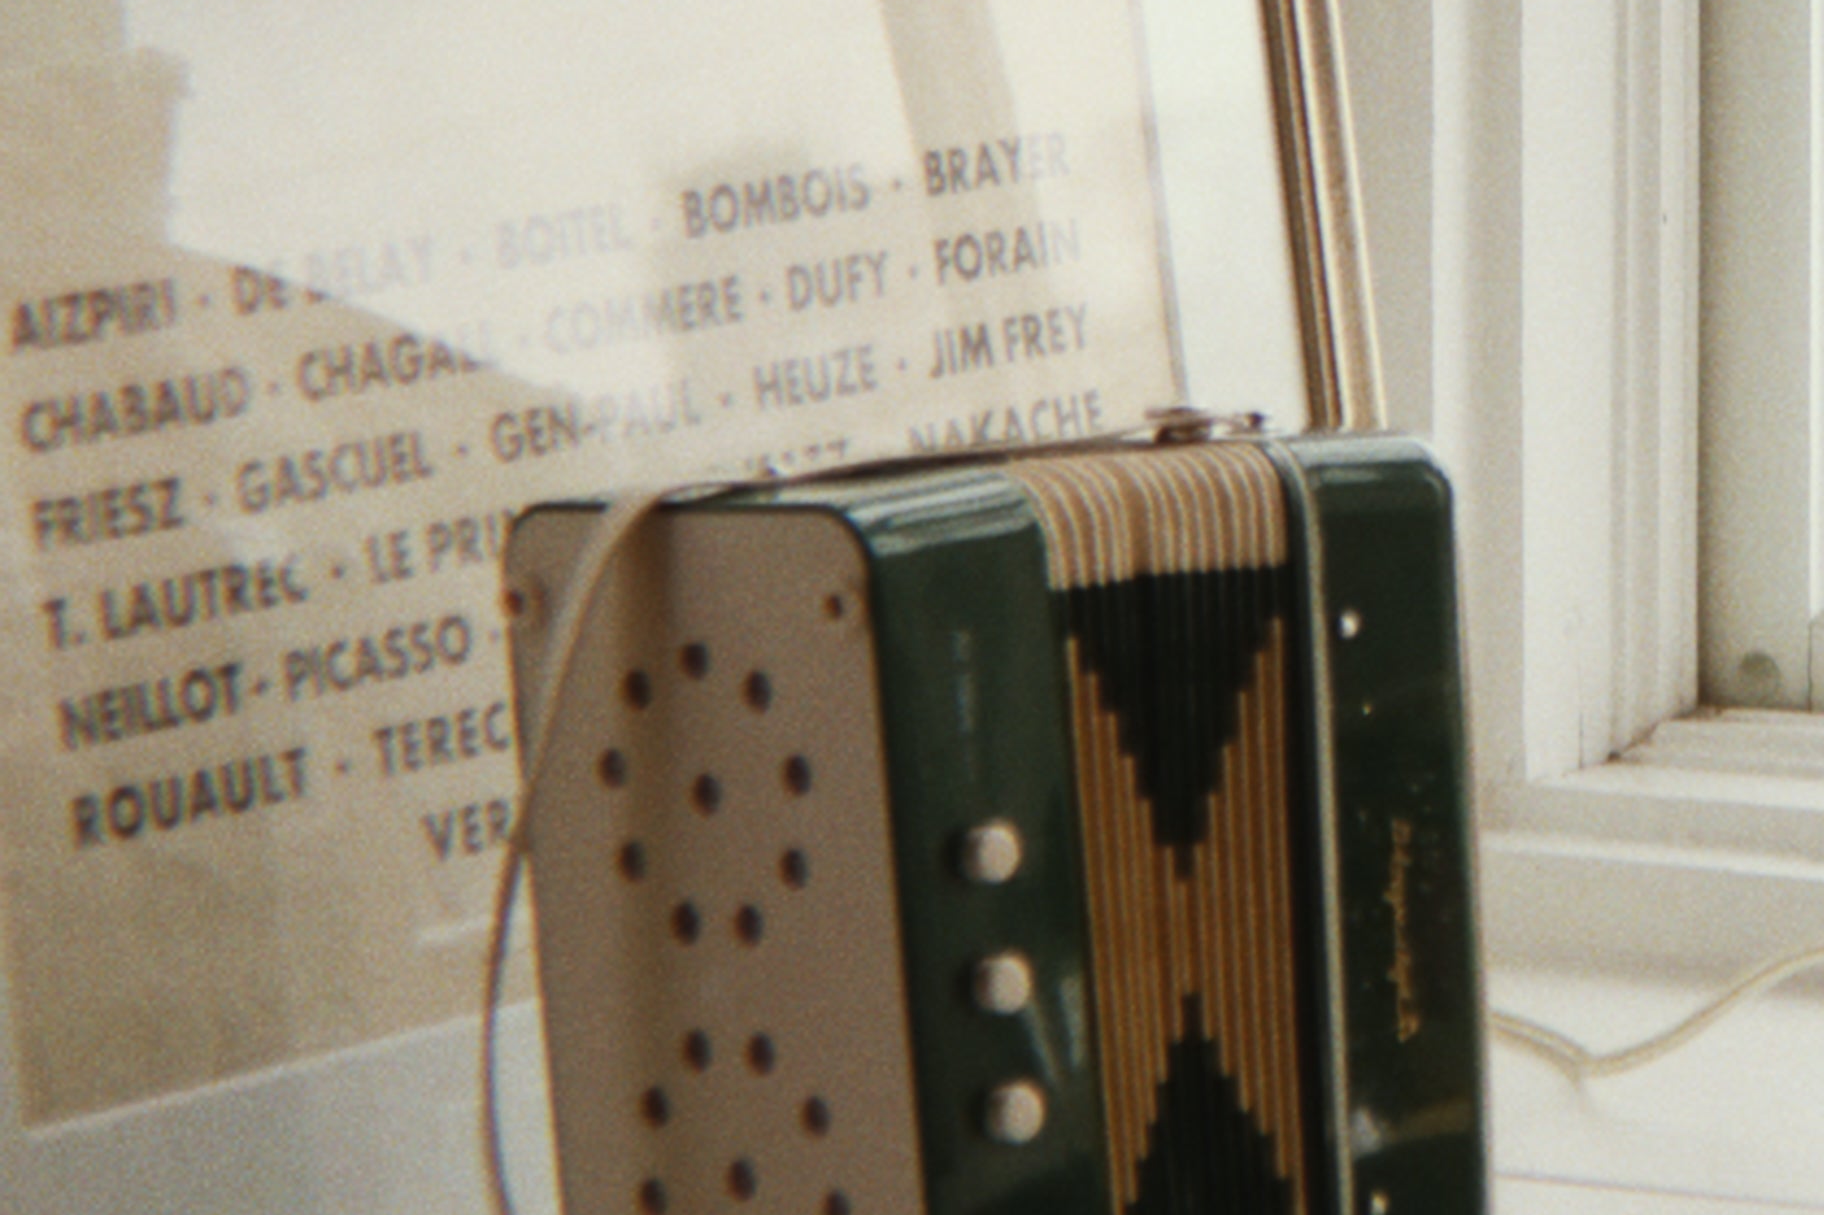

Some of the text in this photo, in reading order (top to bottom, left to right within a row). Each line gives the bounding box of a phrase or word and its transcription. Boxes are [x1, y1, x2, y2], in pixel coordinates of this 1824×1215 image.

[231, 264, 288, 316] DE
[495, 204, 634, 270] BOITEL
[681, 163, 872, 239] BOMBOIS
[923, 132, 1070, 198] BRAYER
[20, 364, 249, 453] CHABAUD
[544, 274, 743, 356] COMMERE
[786, 250, 888, 312] DUFY
[932, 218, 1080, 286] FORAIN
[32, 478, 186, 552] FRIESZ
[235, 432, 433, 514] GASCUEL
[753, 344, 878, 412] HEUZE
[928, 320, 995, 380] JIM
[1003, 302, 1087, 364] FREY
[41, 597, 87, 650] T.
[99, 553, 310, 641] LAUTREC
[364, 530, 414, 584] LE
[424, 508, 512, 576] PRI
[58, 616, 472, 753] NEILLOT PICASSO
[68, 747, 308, 851] ROUAULT
